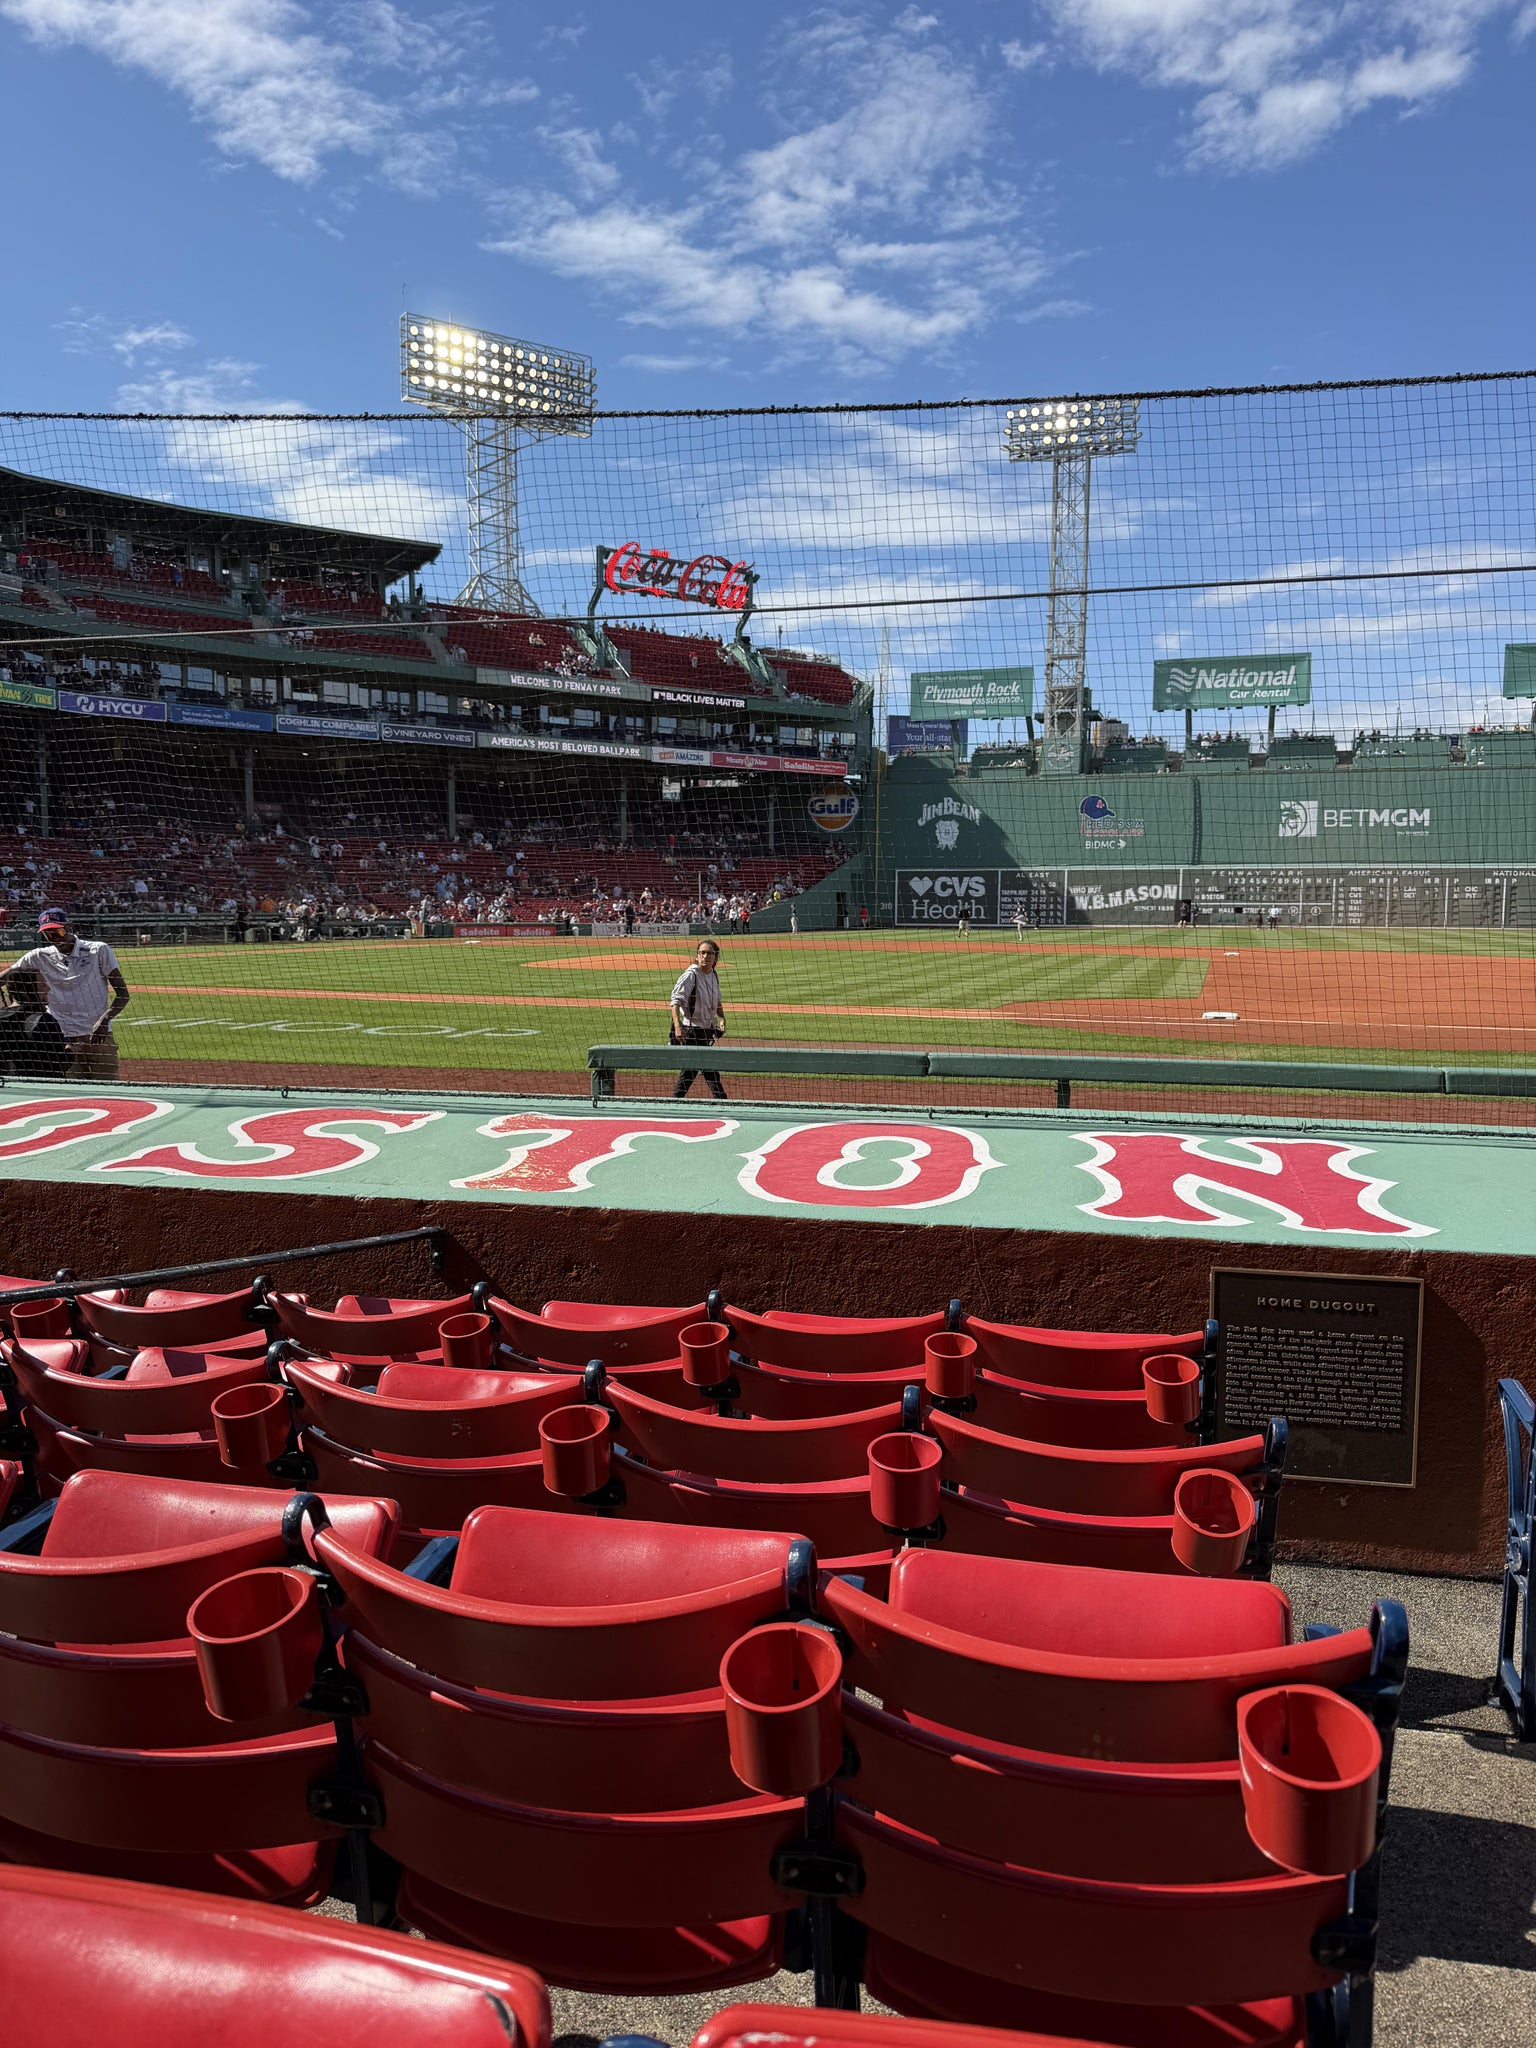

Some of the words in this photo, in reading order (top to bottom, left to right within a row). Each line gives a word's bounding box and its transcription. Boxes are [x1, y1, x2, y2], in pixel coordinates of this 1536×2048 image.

[1195, 665, 1297, 689] National
[511, 675, 550, 688] WELCOME
[552, 680, 562, 689] TO
[564, 681, 598, 693] FENWAY
[600, 684, 621, 695] PARK
[923, 683, 984, 700] Plymouth
[986, 681, 1021, 697] Rock
[35, 694, 53, 705] TIRE
[666, 692, 692, 703] BLACK
[693, 695, 715, 705] LIVES
[716, 697, 745, 708] MATTER
[1230, 690, 1249, 699] Car
[1253, 688, 1290, 698] Rental
[98, 700, 143, 715] HYCU
[280, 718, 320, 727] COGHLIN
[322, 720, 377, 732] COMPANIES
[393, 729, 442, 740] VINEYARD
[443, 733, 471, 742] VINES
[906, 733, 923, 741] Your
[491, 737, 536, 748] AMERICA'S
[538, 740, 559, 750] MOST
[562, 742, 598, 753] BELOVED
[600, 745, 641, 757] BALLPARK
[784, 761, 815, 770] Safelite
[810, 798, 856, 814] Gulf
[917, 802, 943, 827] JIM
[943, 797, 982, 826] BEAM
[1087, 819, 1113, 829] RED
[1118, 819, 1144, 828] SOX
[1324, 808, 1431, 828] BETMGM
[1085, 841, 1116, 849] BIDMC
[934, 876, 986, 897] CVS
[880, 902, 892, 910] 310
[460, 928, 500, 936] Safelite
[513, 928, 551, 936] Safelite
[1257, 1297, 1302, 1308] HOME
[1309, 1300, 1375, 1312] DUGOUT
